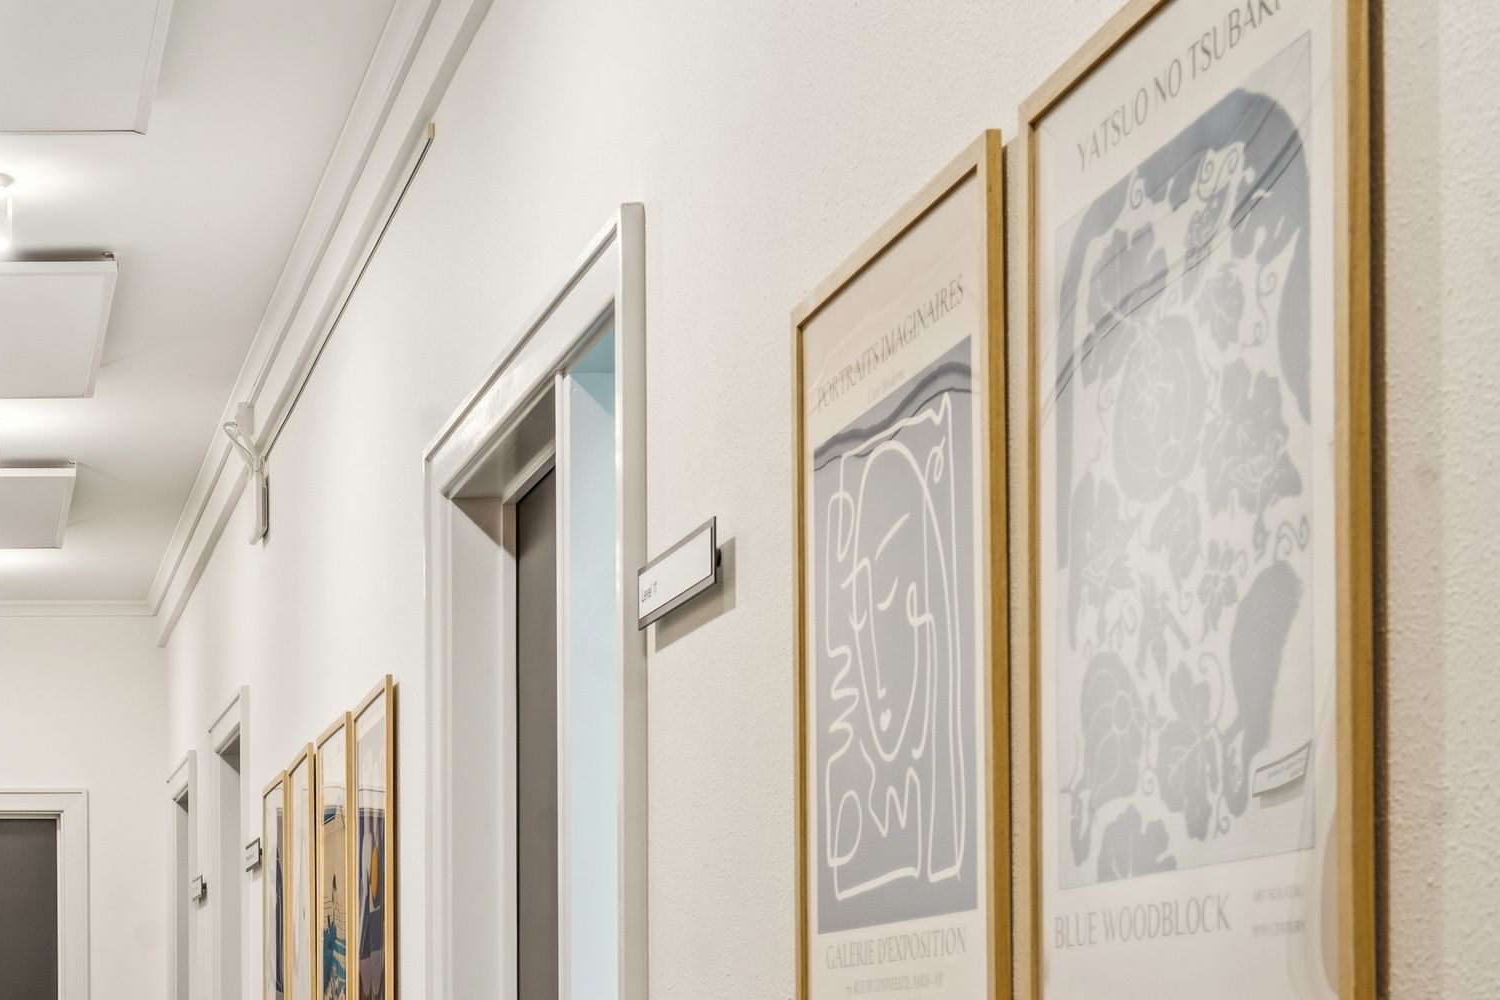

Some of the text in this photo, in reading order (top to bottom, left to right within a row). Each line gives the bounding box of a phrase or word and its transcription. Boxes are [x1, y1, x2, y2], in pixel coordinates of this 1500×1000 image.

[1077, 0, 1281, 172] YATSUO NO TSUBAK
[818, 343, 880, 412] PORTRAITS
[880, 273, 965, 363] IMAGINAIRES
[826, 926, 967, 970] GALERIE D'EXPOSITION
[1055, 893, 1232, 949] BLUE WOODBLOCK
